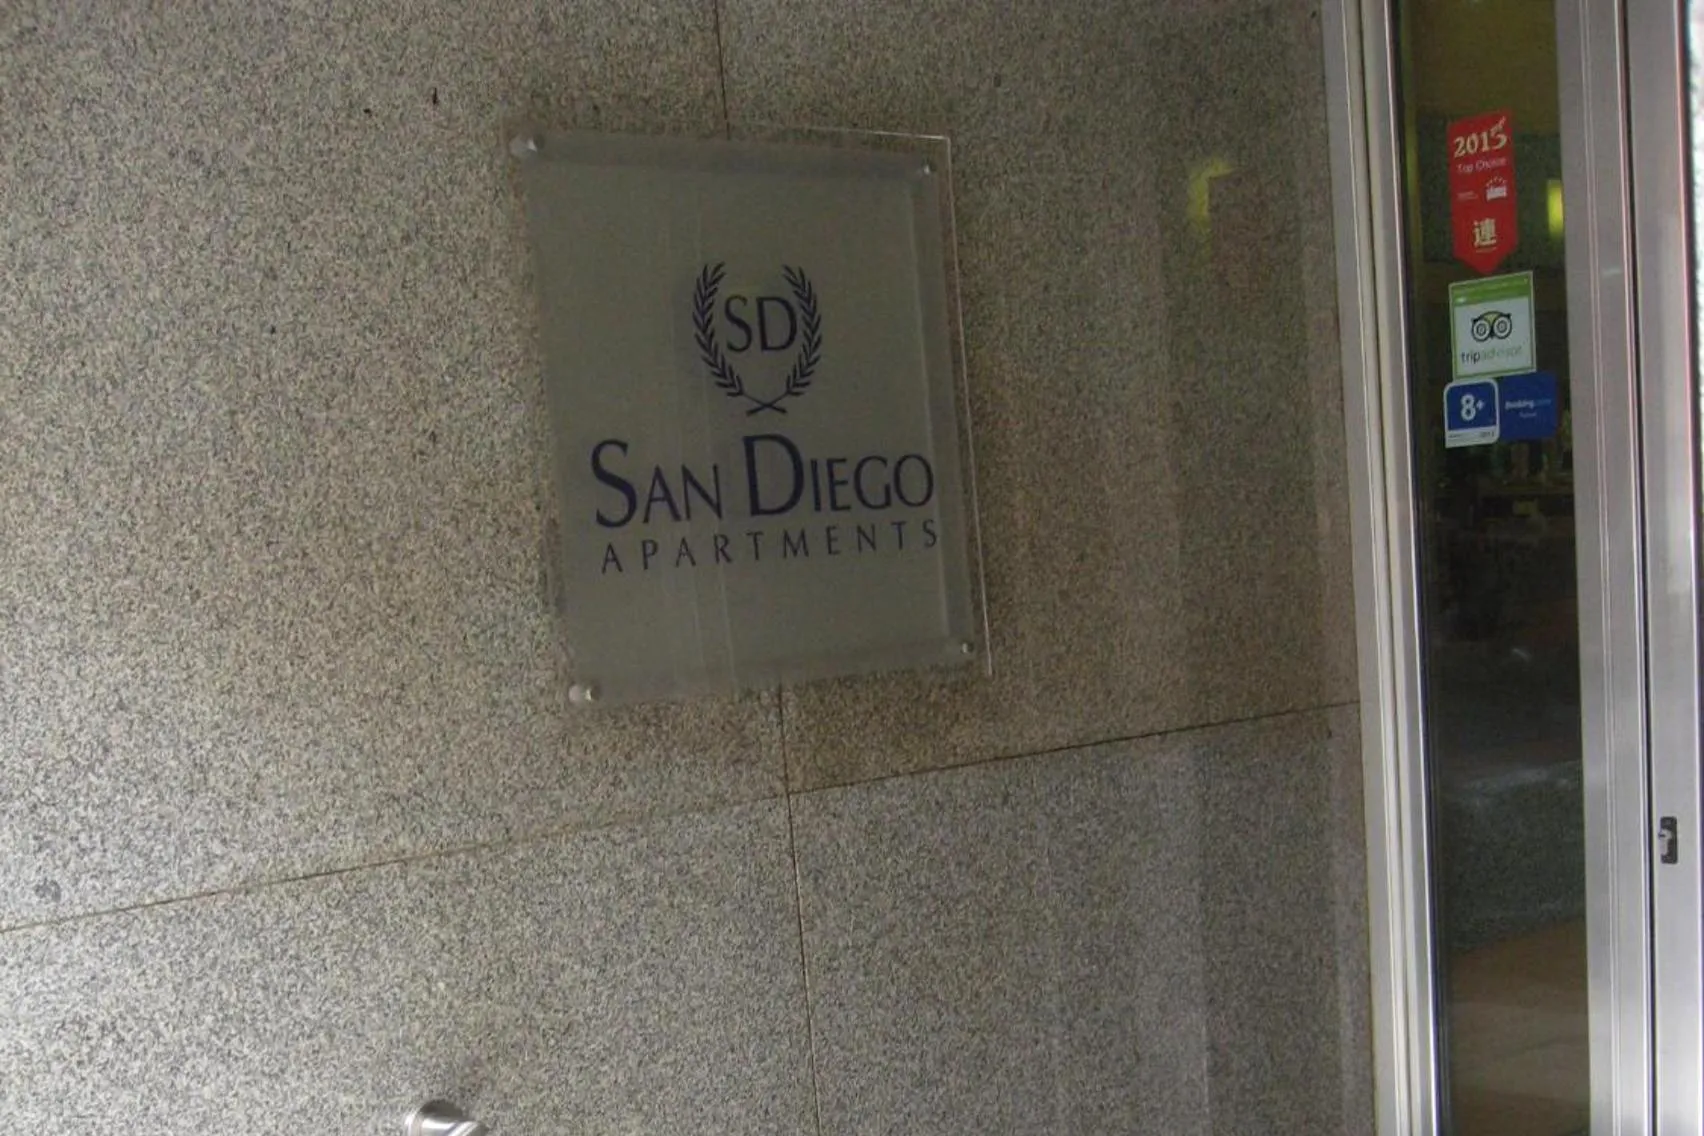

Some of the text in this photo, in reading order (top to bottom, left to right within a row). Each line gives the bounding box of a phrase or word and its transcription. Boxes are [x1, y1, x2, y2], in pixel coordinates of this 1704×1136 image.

[1454, 116, 1507, 158] 2015
[724, 294, 798, 353] SD
[590, 433, 935, 529] SAN DIEGO
[601, 518, 938, 575] APARTMENTS
